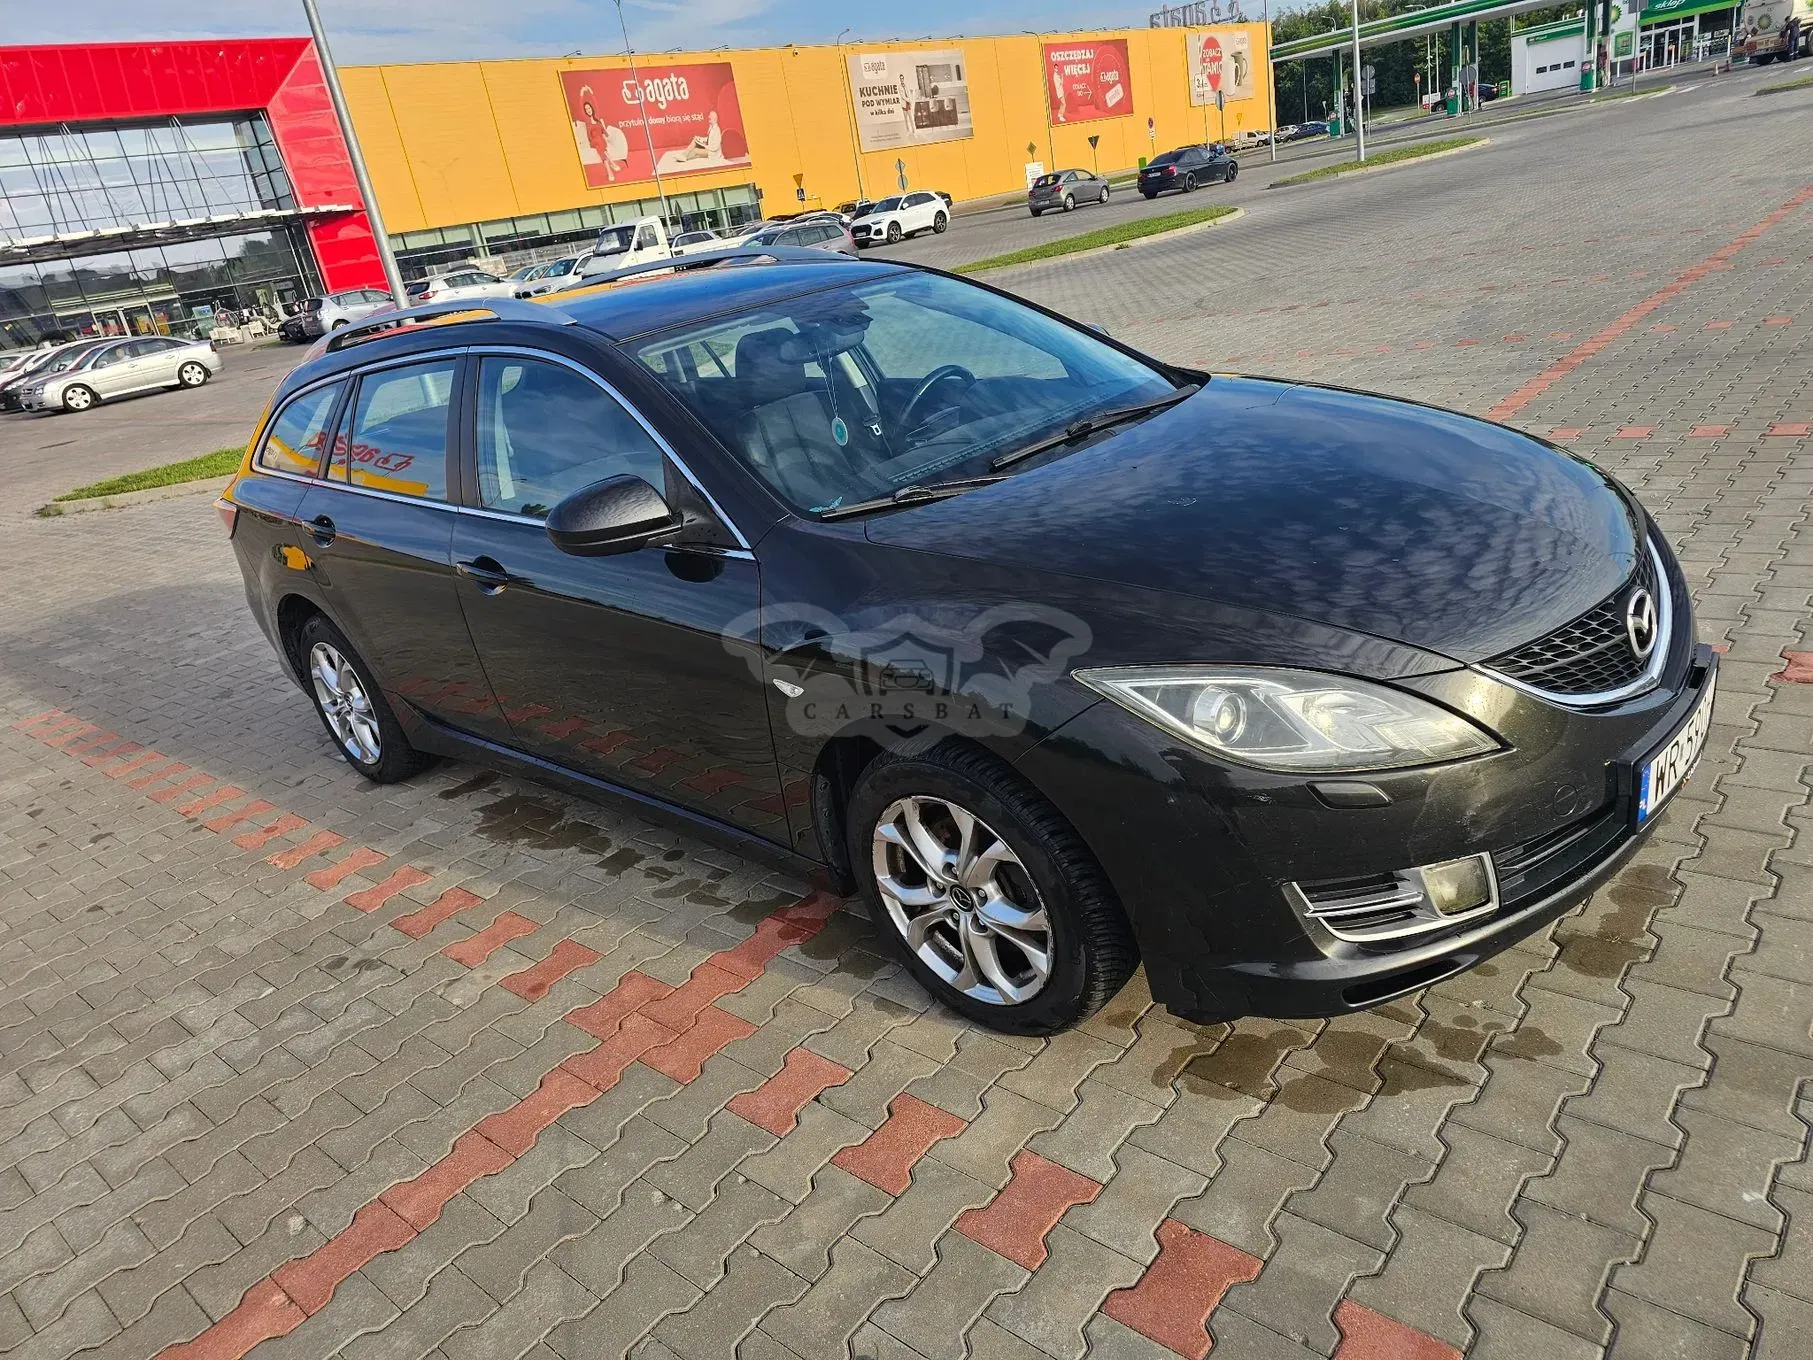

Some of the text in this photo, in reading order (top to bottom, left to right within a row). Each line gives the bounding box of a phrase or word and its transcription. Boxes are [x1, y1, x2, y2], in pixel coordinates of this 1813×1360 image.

[1064, 64, 1090, 77] WIĘCEJ
[644, 73, 689, 109] agata
[859, 85, 898, 98] KUCHNIE
[876, 98, 900, 106] WYMIAR
[618, 118, 647, 129] przytuln
[648, 116, 665, 125] domy
[1655, 740, 1680, 801] WR
